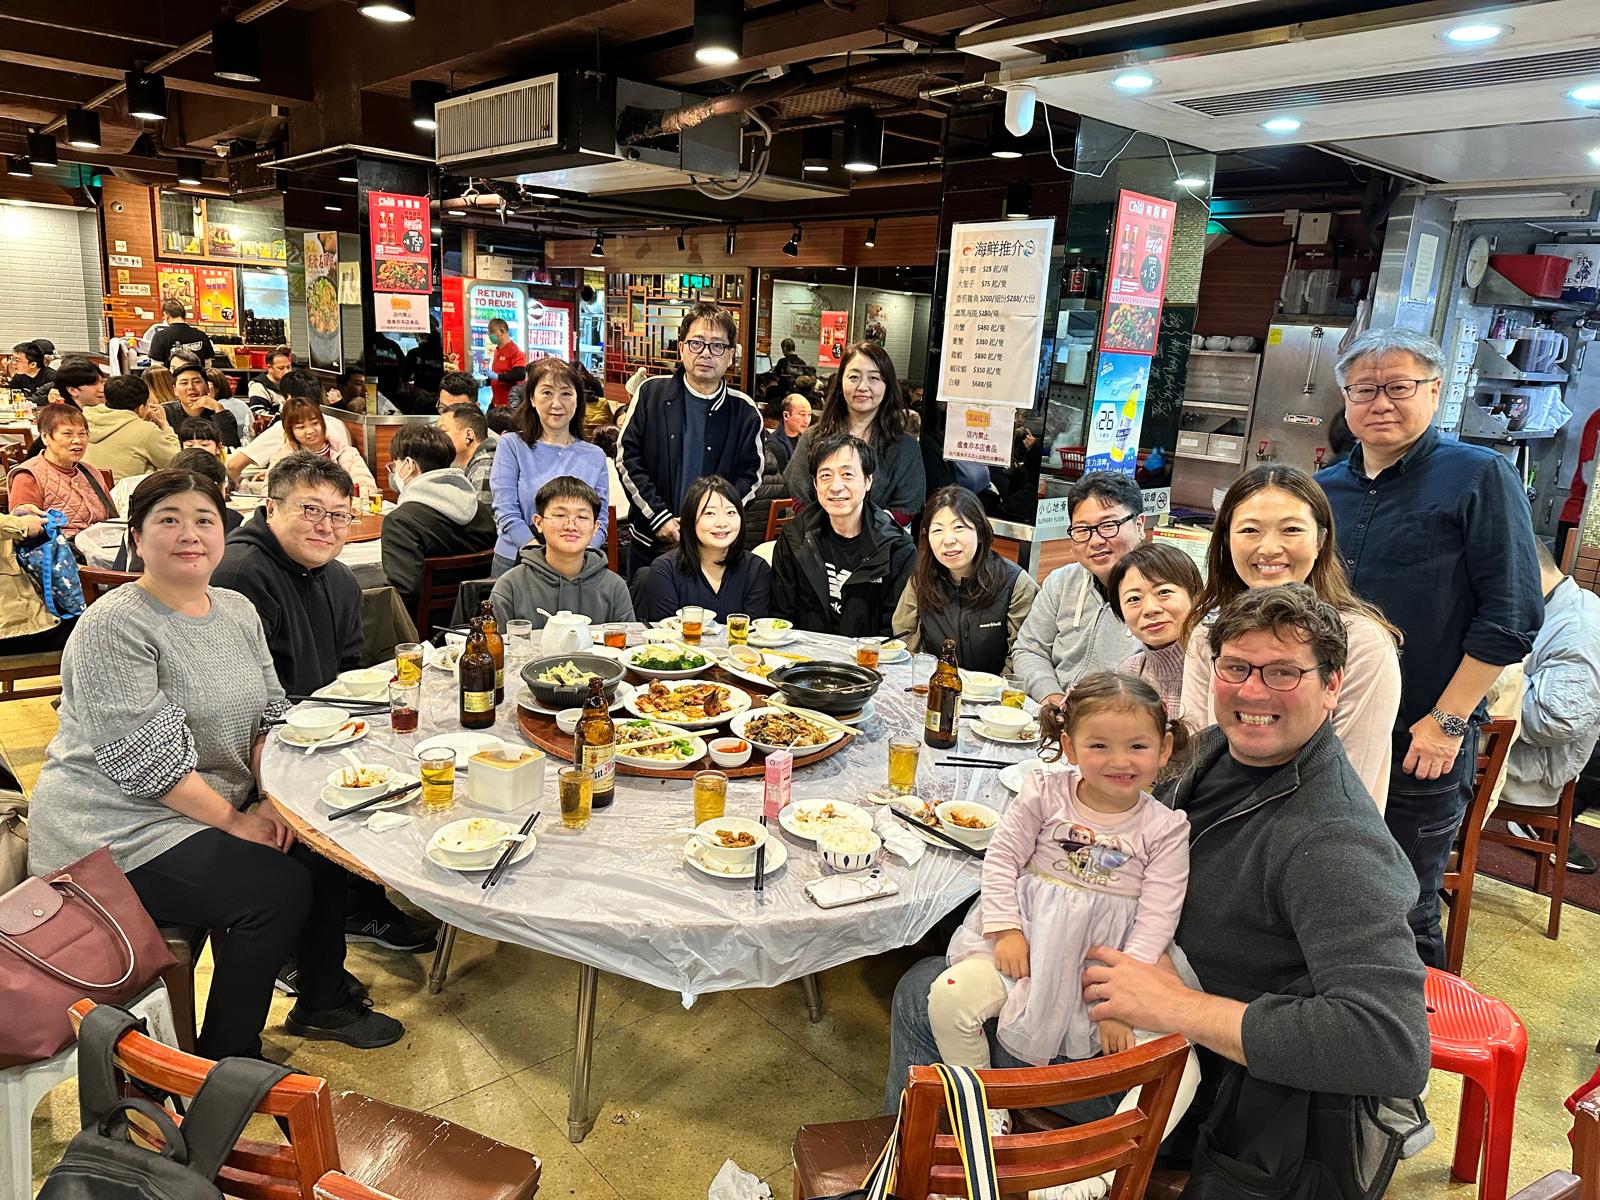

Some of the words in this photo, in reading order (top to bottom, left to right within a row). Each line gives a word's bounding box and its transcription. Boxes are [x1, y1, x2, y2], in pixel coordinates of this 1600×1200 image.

[477, 289, 514, 298] RETURN
[474, 298, 487, 306] TO
[488, 299, 517, 308] REUSE
